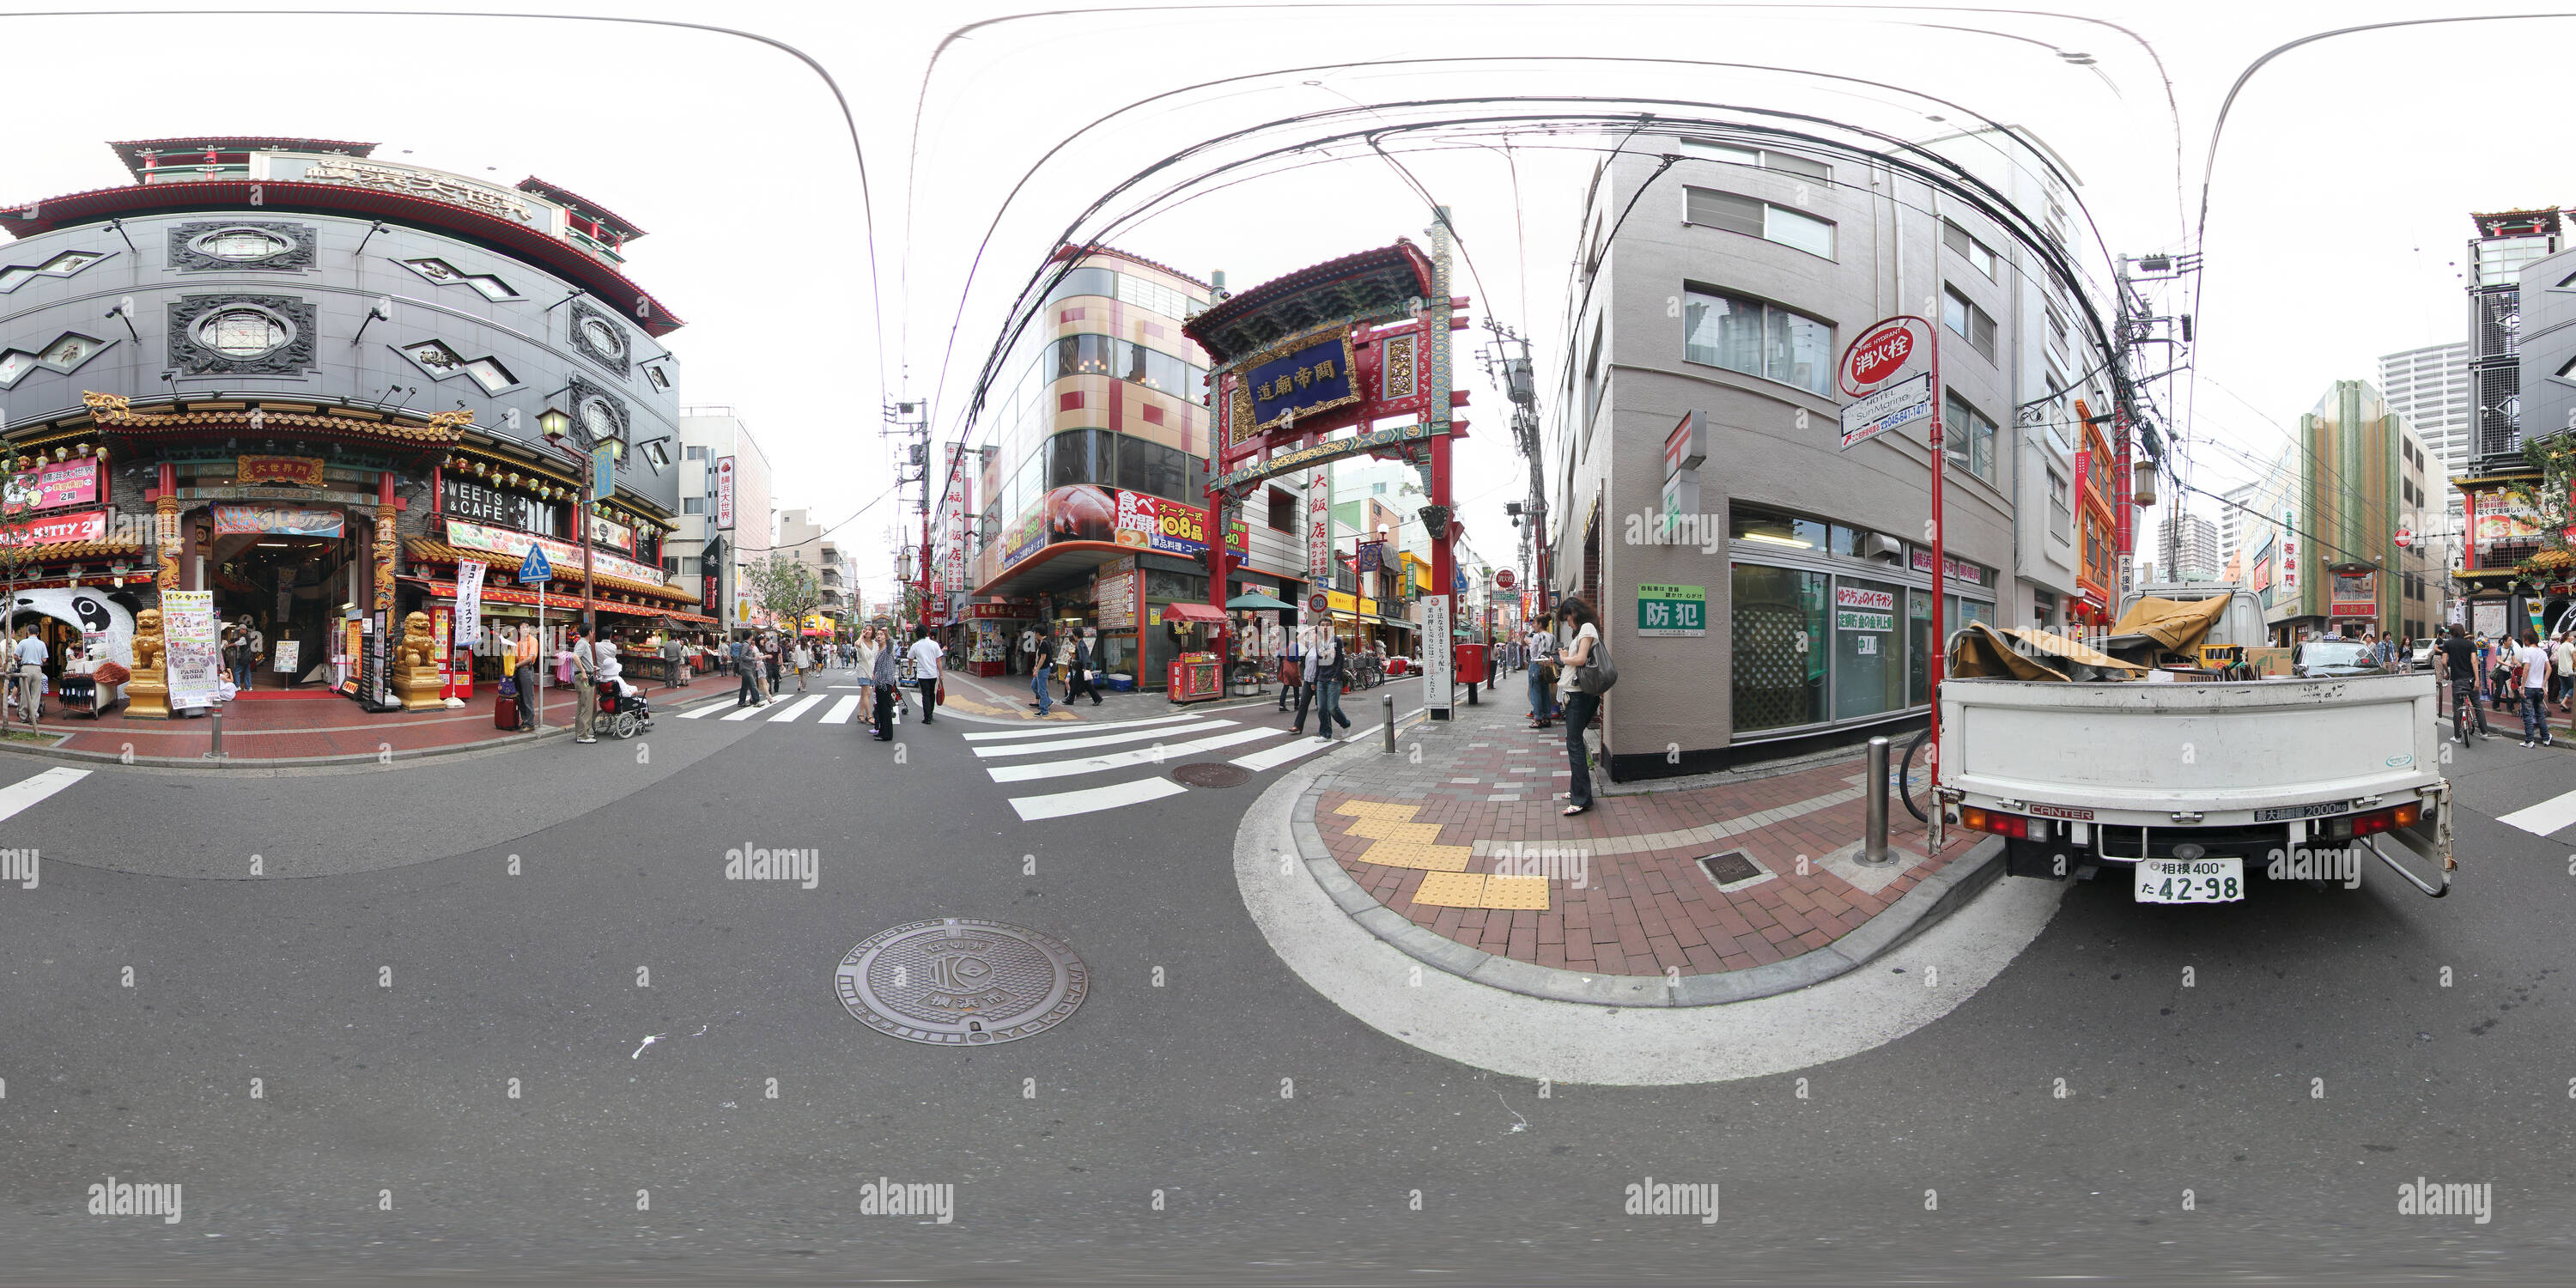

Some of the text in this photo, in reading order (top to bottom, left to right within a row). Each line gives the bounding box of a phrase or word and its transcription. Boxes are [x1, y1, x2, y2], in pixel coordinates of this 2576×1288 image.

[1859, 327, 1902, 353] FIRE HYDRANT
[1856, 335, 1909, 376] 消火栓
[1866, 391, 1896, 407] HOTEL
[1887, 403, 1928, 428] 045-641-1471
[42, 465, 95, 484] 横浜大世界
[256, 462, 307, 475] 大世界門
[60, 491, 76, 501] 2階
[440, 481, 503, 506] SWEETS
[720, 475, 731, 520] 横浜大世界
[1117, 490, 1155, 513] 食べ
[450, 501, 503, 521] & CAFE
[1159, 503, 1203, 522] オーダー式
[2477, 507, 2524, 516] 安くて美味しい
[33, 522, 79, 538] KITTY
[1117, 511, 1155, 534] 放題
[1319, 540, 1327, 575] 大小宴会
[1912, 550, 1981, 582] 横浜下町郵便局
[1312, 598, 1324, 608] 30
[1838, 588, 1893, 608] ゆうちょのイチオシ
[1646, 602, 1698, 626] 防犯
[2030, 805, 2094, 820] CANTER
[2161, 862, 2220, 875] 相模 400
[2141, 877, 2239, 901] た 42-98
[930, 993, 1006, 1010] 横浜市
[1001, 962, 1087, 1039] YOKOHAMA
